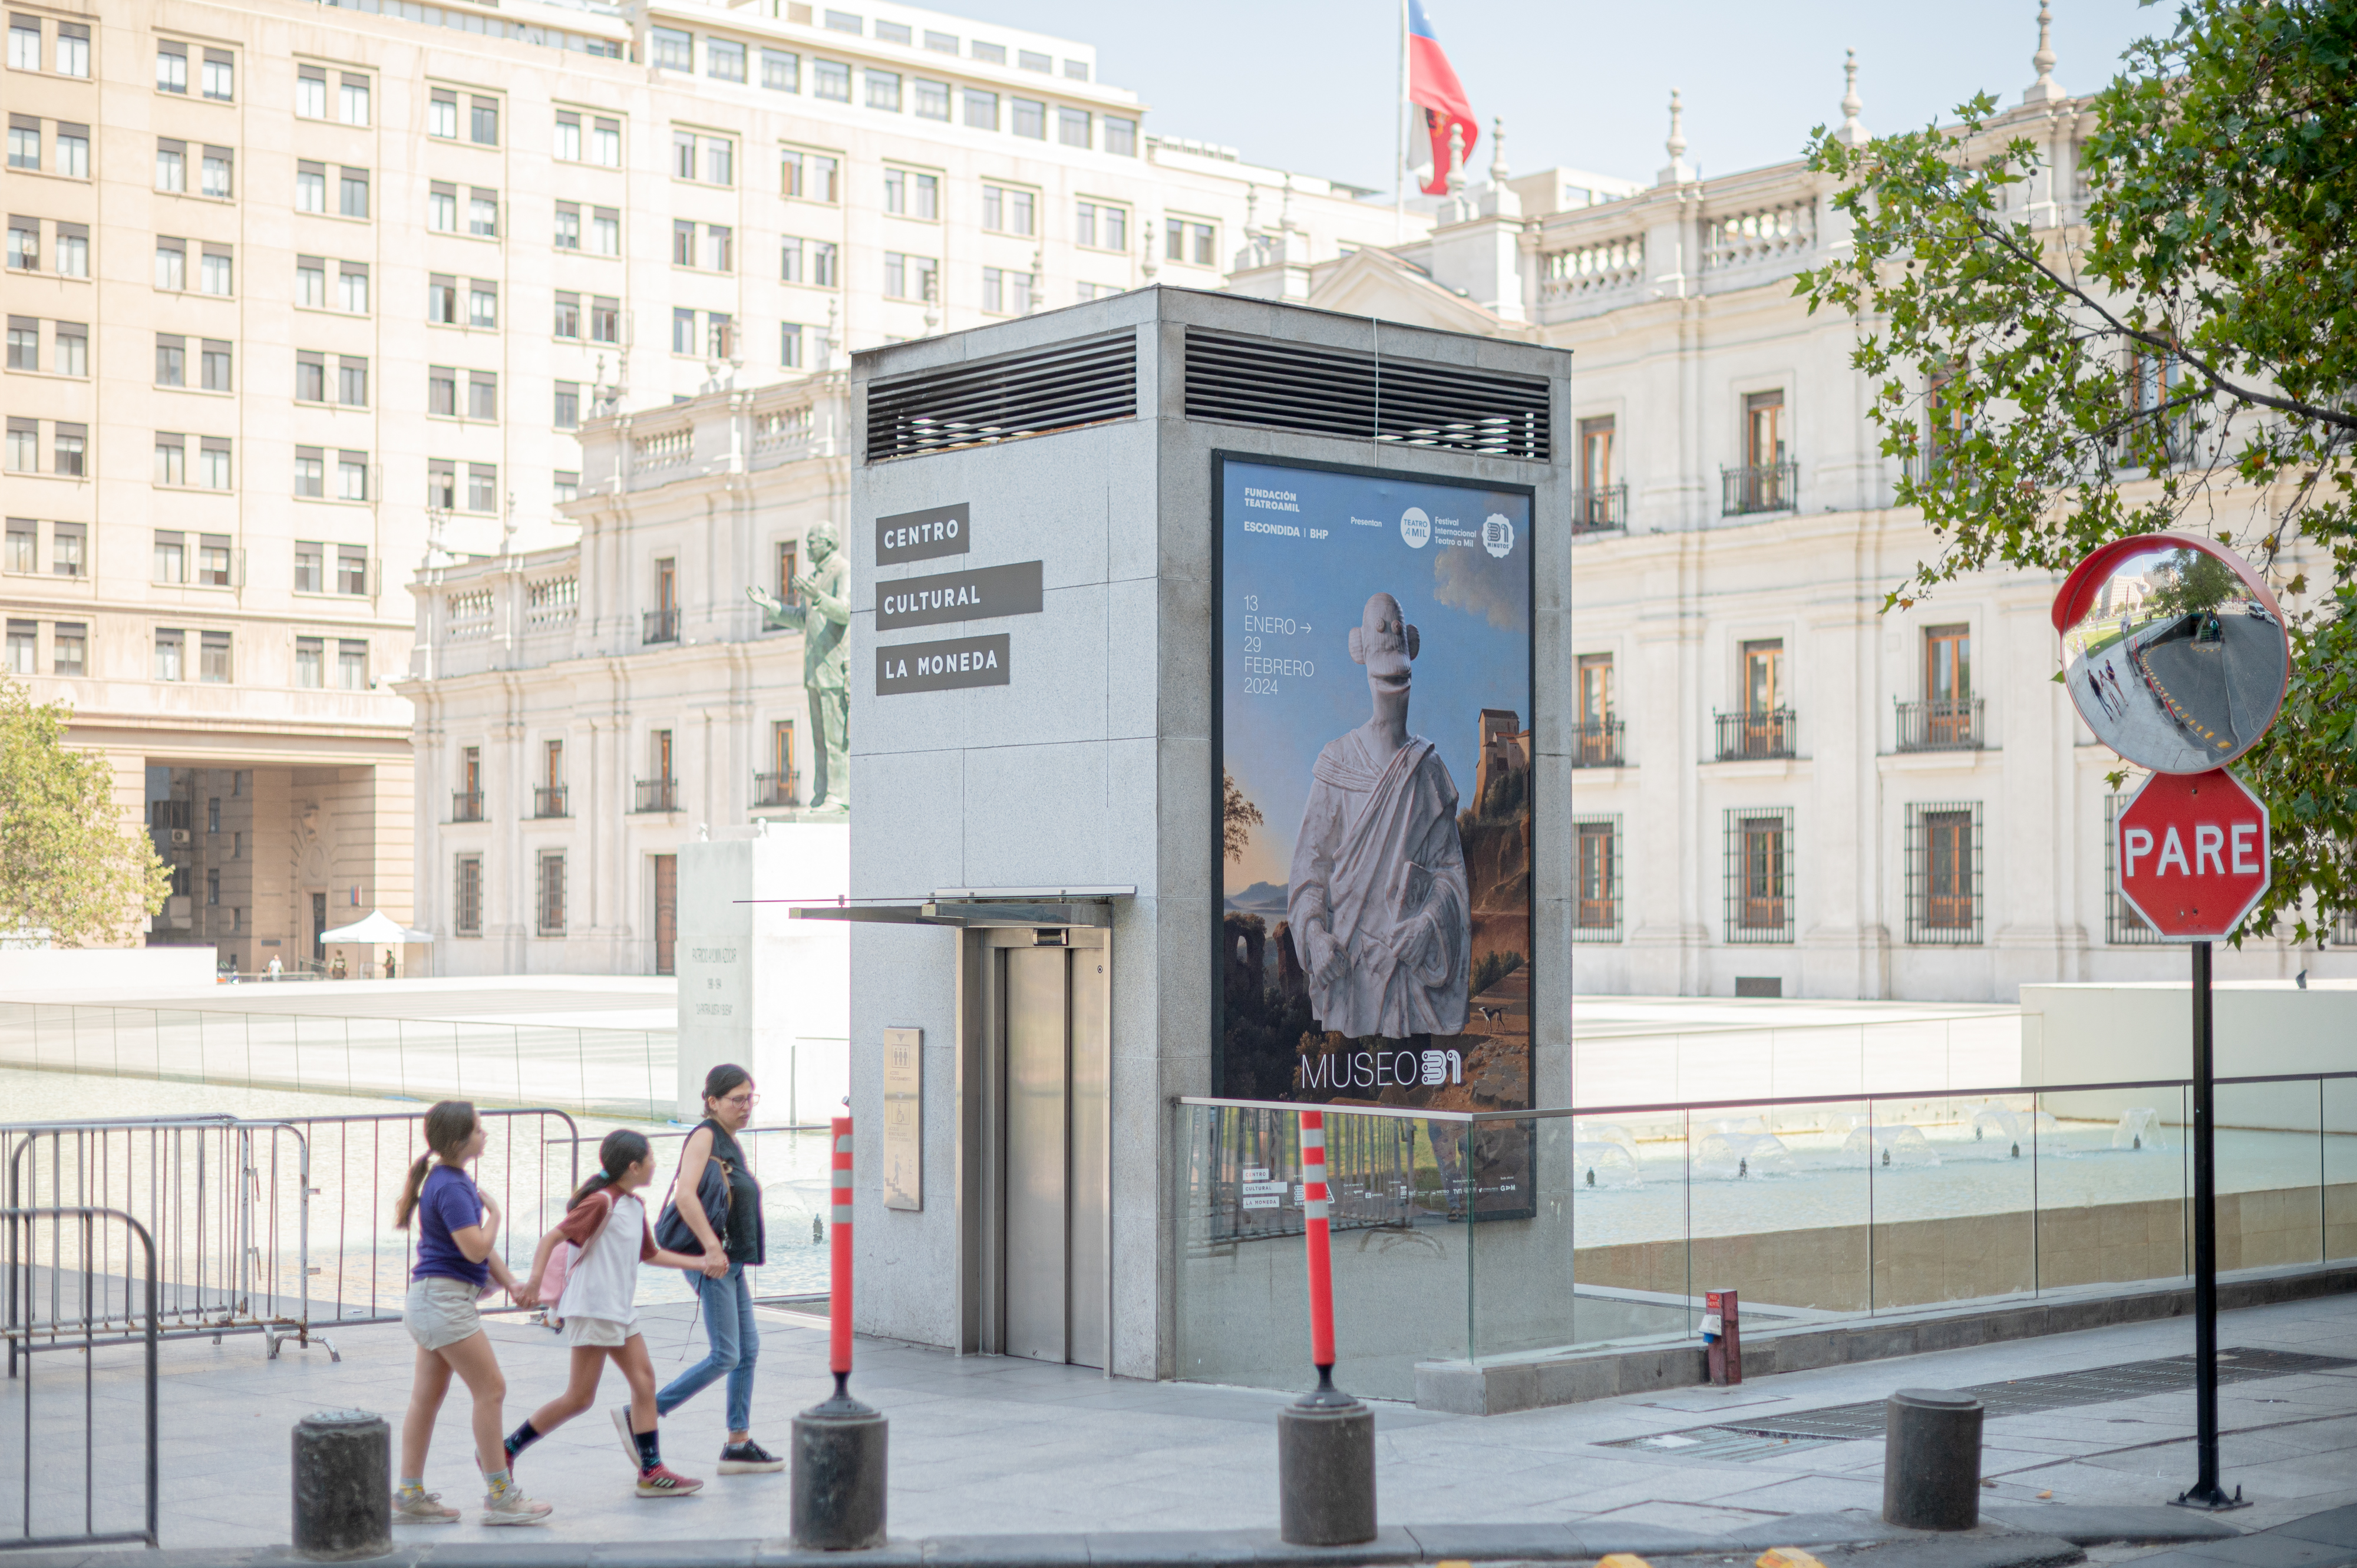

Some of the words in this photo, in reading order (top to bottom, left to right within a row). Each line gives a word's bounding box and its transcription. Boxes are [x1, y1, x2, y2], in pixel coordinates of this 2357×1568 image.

[1244, 487, 1296, 501] FUNDACIÓN
[1244, 498, 1300, 512] TEATROAMIL
[1351, 516, 1382, 527] Presentan
[1404, 519, 1428, 528] TEATRO
[1435, 516, 1459, 526] Festival
[884, 519, 959, 549] CENTRO
[1244, 521, 1300, 537] ESCONDIDA
[1310, 528, 1329, 540] BHP
[1405, 527, 1410, 536] A
[1412, 528, 1427, 537] MIL
[1435, 526, 1477, 538] Internacional
[1435, 536, 1455, 546] Teatro
[1464, 539, 1474, 547] Mil
[884, 585, 981, 615] CULTURAL
[1244, 595, 1258, 611] 13
[1245, 615, 1296, 635] ENERO
[1244, 636, 1262, 653] 29
[886, 659, 907, 679] LA
[918, 649, 998, 676] MONEDA
[1245, 656, 1314, 677] FEBRERO
[1244, 677, 1279, 695] 2024
[2124, 824, 2260, 877] PARE
[1302, 1051, 1417, 1089] MUSEO
[1421, 1049, 1461, 1085] 31
[909, 1159, 912, 1174] E
